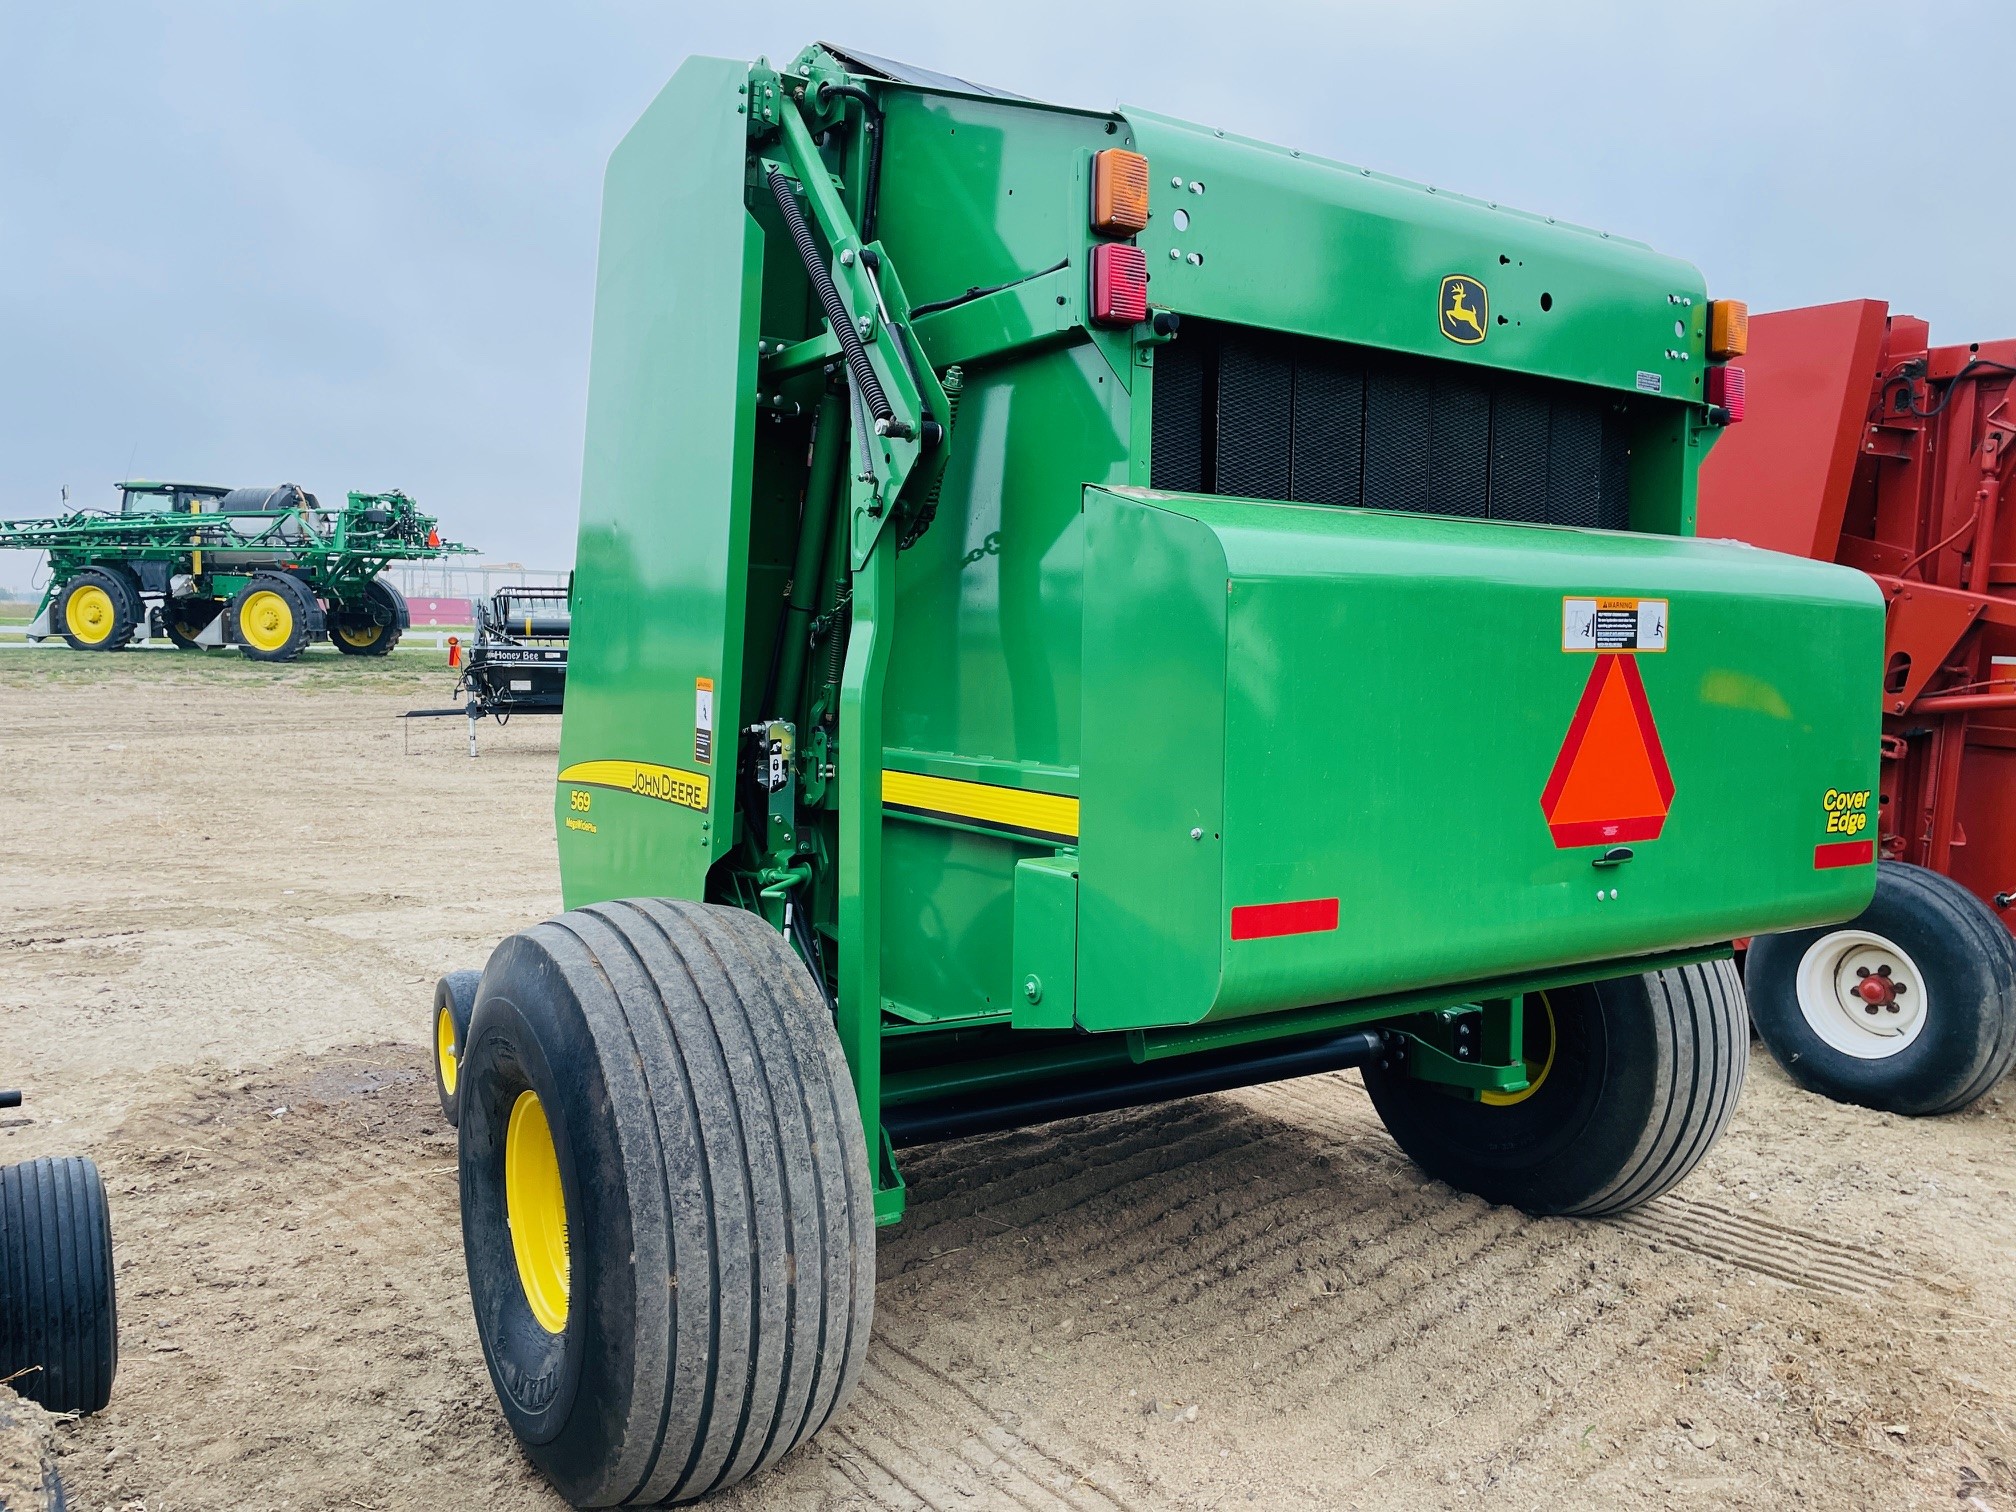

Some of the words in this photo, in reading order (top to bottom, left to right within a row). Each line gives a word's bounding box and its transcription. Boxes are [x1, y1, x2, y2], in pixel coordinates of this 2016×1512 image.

[495, 651, 520, 660] Honey
[522, 651, 539, 660] Bee
[632, 769, 660, 791] JOHN
[661, 774, 702, 806] DEERE
[571, 790, 591, 812] 569
[1823, 788, 1870, 811] Cover
[1826, 810, 1866, 835] Edge
